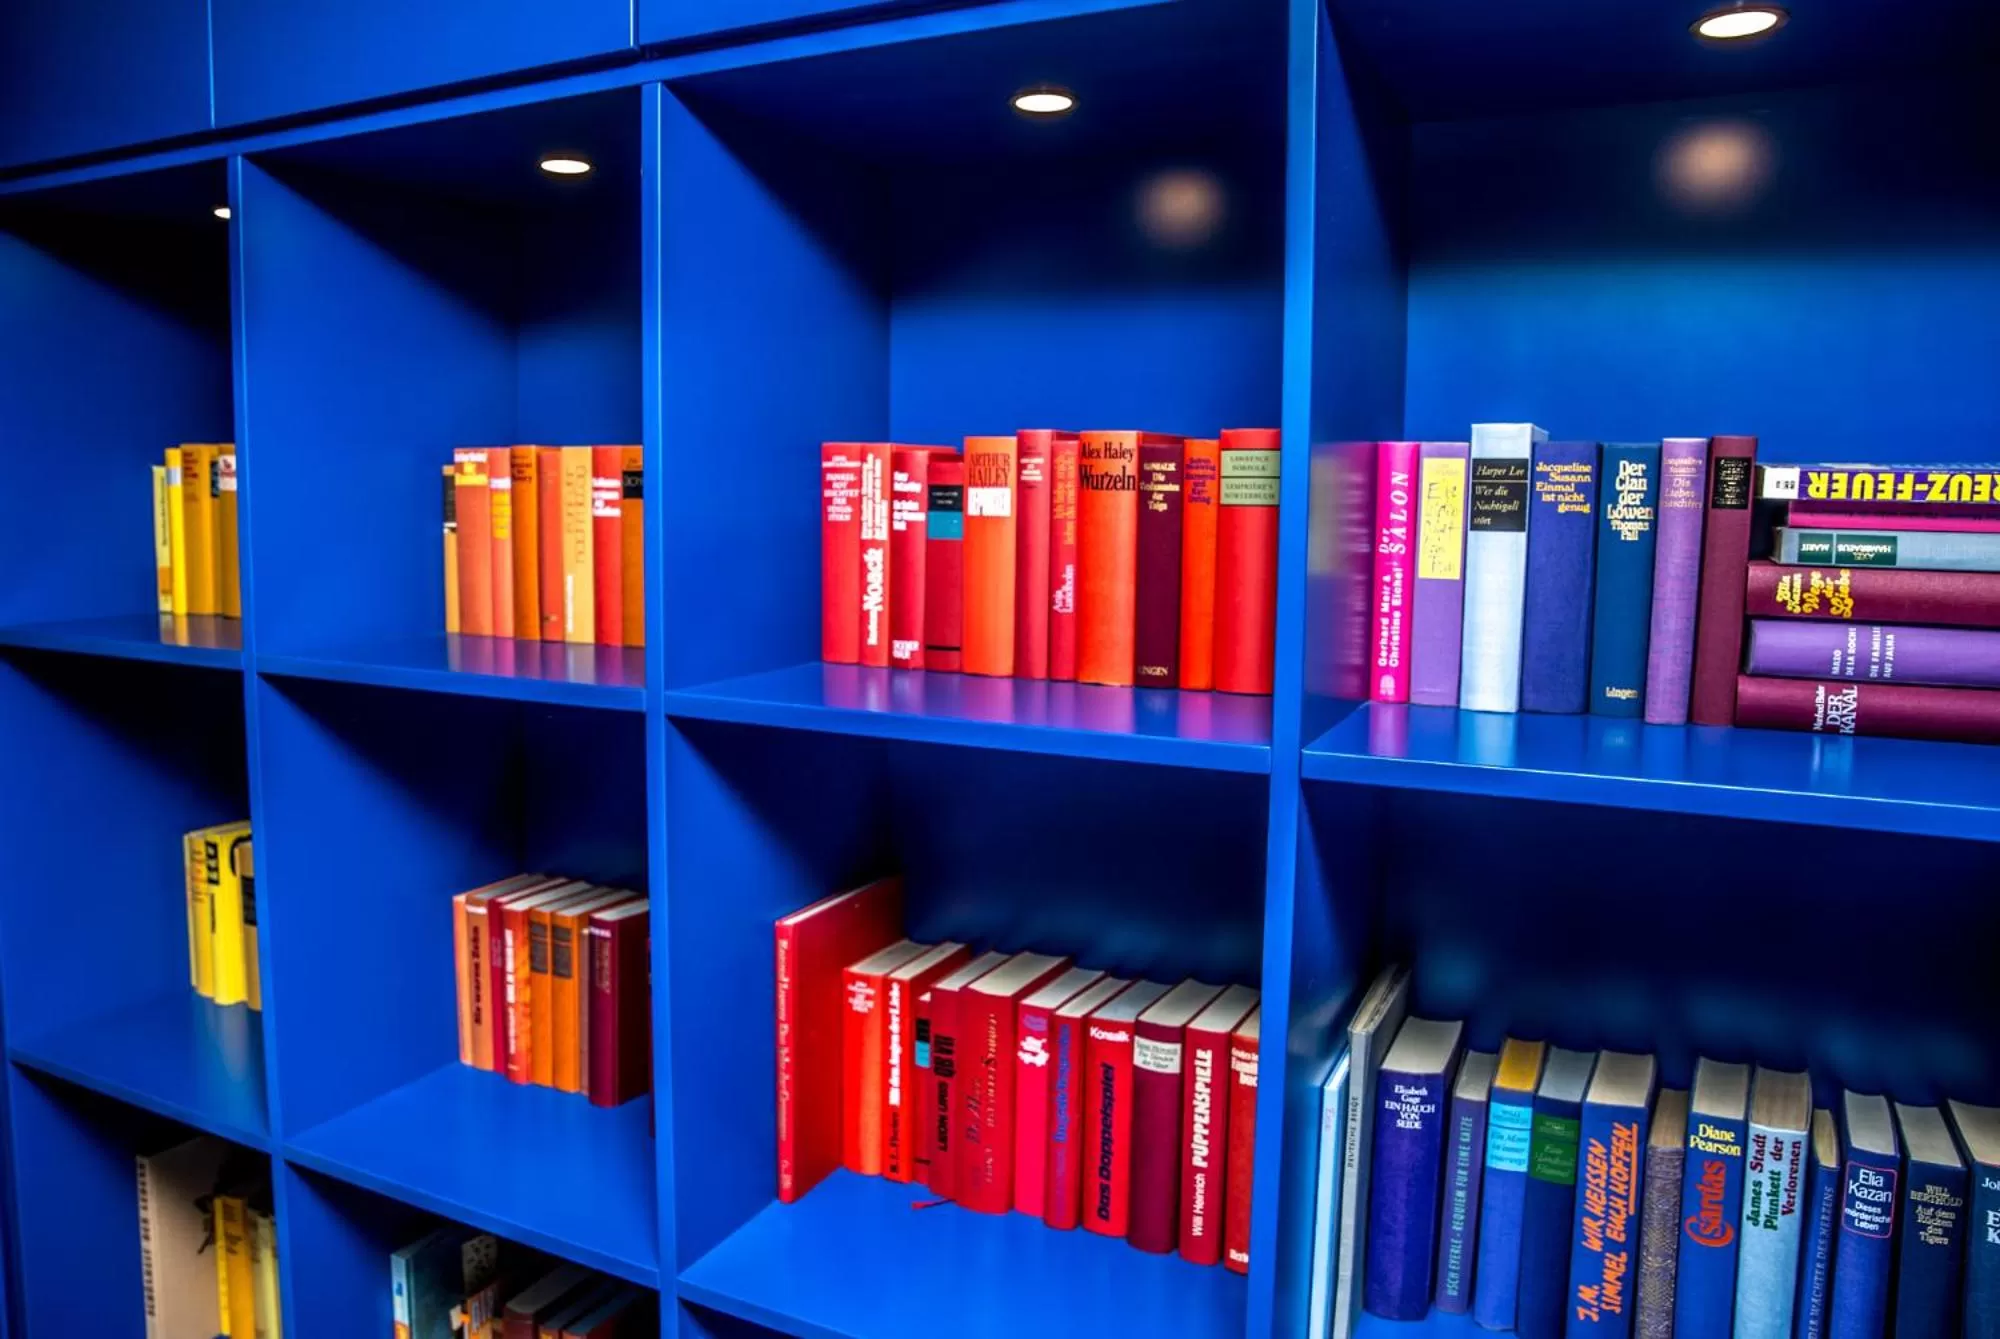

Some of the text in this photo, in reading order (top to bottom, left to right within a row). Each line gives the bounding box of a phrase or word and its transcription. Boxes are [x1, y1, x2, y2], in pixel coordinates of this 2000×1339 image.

[969, 453, 1010, 467] ARTHUR
[1081, 442, 1134, 463] Alex Haley
[968, 467, 1010, 487] HAILEY
[1079, 465, 1136, 491] Wurzeln
[1477, 466, 1524, 478] Harper Lee
[1535, 462, 1592, 473] Jacqueline
[1549, 472, 1591, 482] Susann
[1619, 460, 1647, 476] Der
[1475, 486, 1508, 496] Wer die
[1535, 481, 1575, 492] Einmal
[1615, 475, 1648, 491] Clan
[1474, 500, 1520, 513] Nachtigall
[1542, 492, 1585, 502] ist nicht
[1618, 489, 1645, 505] der
[1388, 472, 1408, 554] SALON
[1557, 503, 1591, 514] genug
[1607, 504, 1654, 519] Löwen
[1379, 528, 1390, 554] Der
[863, 548, 883, 612] Noack
[1822, 577, 1834, 598] der
[1802, 570, 1825, 613] Wege
[1830, 568, 1854, 618] Liebe
[1389, 567, 1403, 668] Christine Eichel
[1378, 617, 1390, 667] Gerhard
[1846, 655, 1855, 666] LA
[1869, 665, 1880, 678] DIE
[1826, 695, 1843, 726] DER
[1839, 685, 1858, 734] KANAL
[1385, 1100, 1436, 1114] EIN HAUCH
[1400, 1111, 1420, 1121] VON
[1395, 1119, 1423, 1130] SEIDE
[1459, 1115, 1473, 1143] KATZE
[1699, 1124, 1736, 1141] Diane
[1097, 1063, 1116, 1221] Das Doppelspiel
[1690, 1135, 1742, 1156] Pearson
[1769, 1137, 1784, 1162] der
[1457, 1146, 1470, 1168] EINE
[1749, 1134, 1767, 1173] Stadt
[1606, 1121, 1633, 1244] EUCH HOFFEN
[1781, 1140, 1802, 1216] Verlorenen
[1859, 1169, 1884, 1187] Elia
[1194, 1173, 1206, 1214] Heinrich
[1581, 1137, 1609, 1252] WIR HEISSEN
[1763, 1170, 1782, 1231] Plunkett
[1848, 1180, 1892, 1203] Kazan
[1910, 1190, 1963, 1207] BERTHOLD
[1925, 1184, 1950, 1197] WILL
[1451, 1190, 1467, 1231] REQUIEM
[1684, 1159, 1735, 1248] Csardas
[1746, 1180, 1763, 1227] James
[1818, 1186, 1834, 1236] HERZENS
[1855, 1201, 1882, 1214] Dieses
[1916, 1205, 1956, 1220] Auf dem
[1854, 1218, 1880, 1231] Leben
[1917, 1214, 1953, 1228] Rücken
[1926, 1225, 1943, 1235] des
[1817, 1238, 1828, 1260] DES
[1919, 1232, 1949, 1246] Tigers
[1600, 1251, 1629, 1315] SIMMEL
